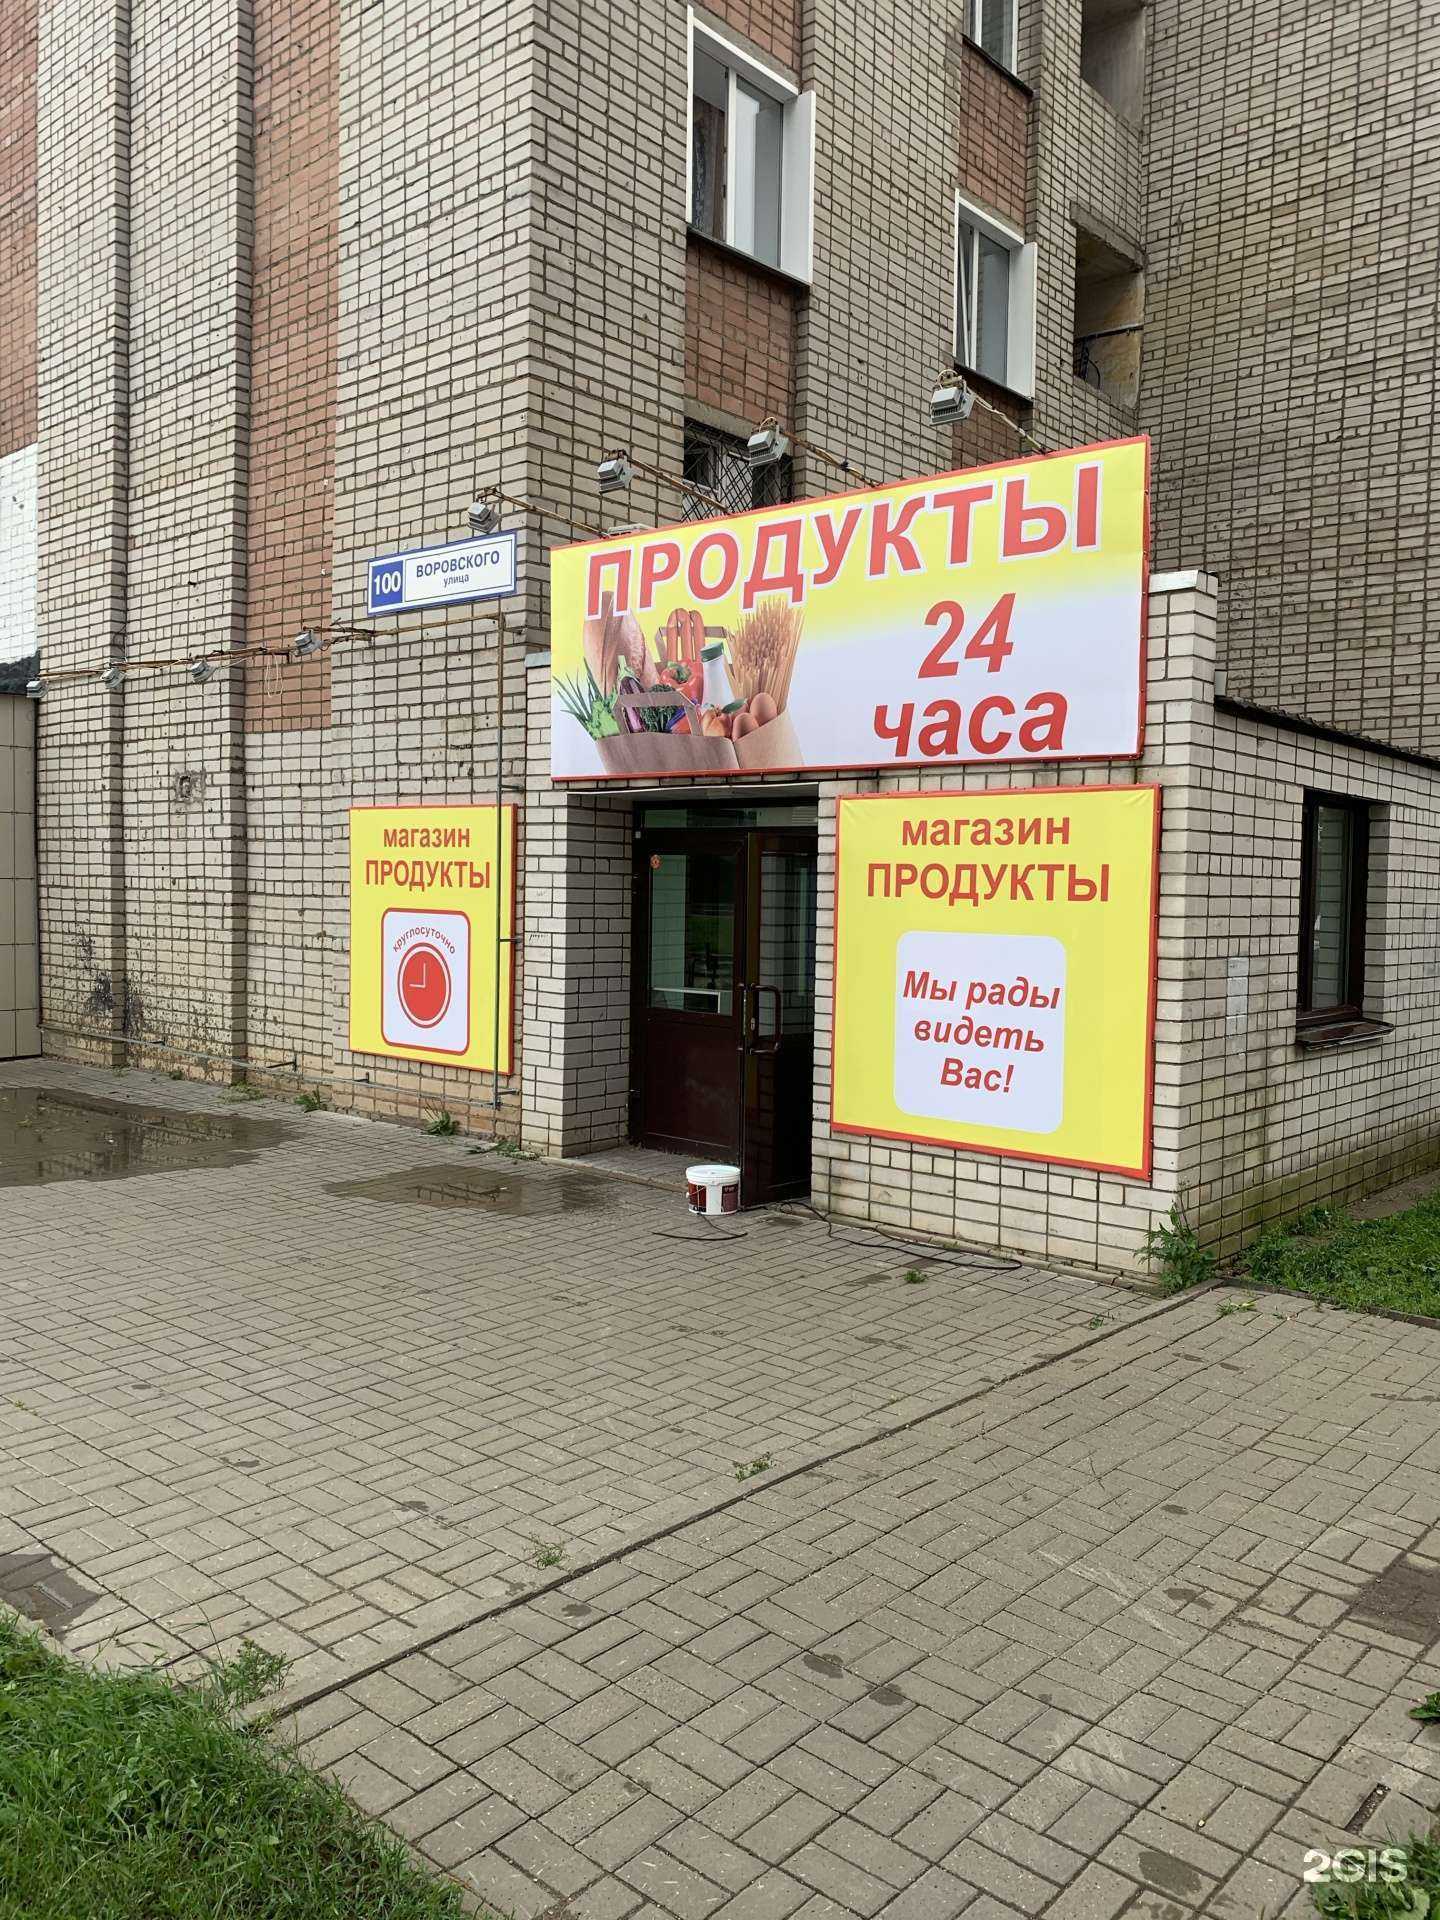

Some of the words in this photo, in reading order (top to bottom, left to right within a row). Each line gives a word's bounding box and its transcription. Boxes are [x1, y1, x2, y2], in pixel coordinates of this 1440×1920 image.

[586, 464, 1103, 621] ПРОДУКТЫ
[416, 550, 500, 578] ВОРОВСКОГО
[443, 573, 469, 588] улица
[373, 571, 402, 595] 100
[917, 592, 1016, 679] 24
[873, 691, 1068, 758] часа
[383, 827, 470, 848] магазин
[901, 816, 1070, 847] магазин
[365, 859, 490, 891] ПРОДУКТЫ
[867, 863, 1109, 907] ПРОДУКТЫ
[392, 926, 456, 954] круглосуточно
[902, 970, 957, 1002] Мы
[965, 976, 1060, 1010] рады
[913, 1016, 1045, 1053] видеть
[940, 1057, 1015, 1093] Вас!
